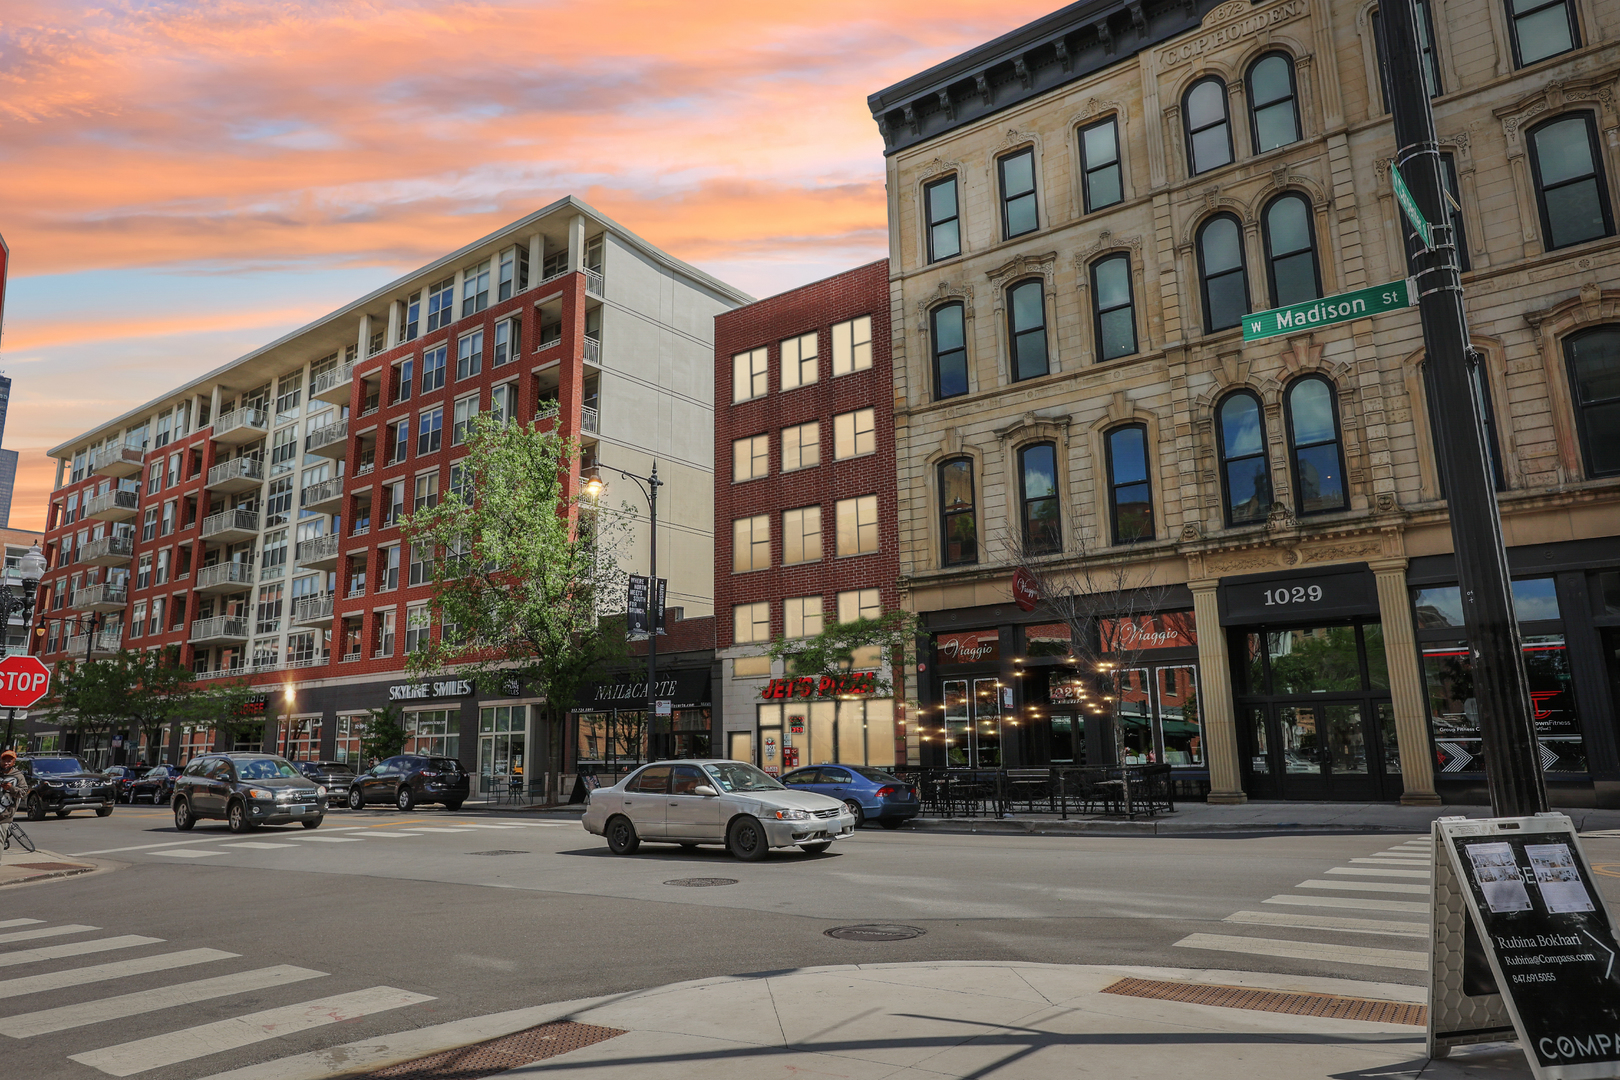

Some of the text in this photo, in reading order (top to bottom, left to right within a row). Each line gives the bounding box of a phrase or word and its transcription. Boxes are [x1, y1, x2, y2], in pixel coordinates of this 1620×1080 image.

[1209, 2, 1245, 24] 1872
[1251, 291, 1399, 333] W Madison St
[1264, 585, 1323, 606] 1029
[1120, 618, 1178, 646] Viaggio
[944, 635, 993, 660] Viaggio
[389, 679, 472, 701] SKYLINE SMILES
[761, 677, 813, 699] JET'S
[1497, 932, 1582, 949] Rubina Bokhari
[1504, 952, 1596, 966] Rubina@Compass.com
[1512, 972, 1557, 984] 847.691.5055
